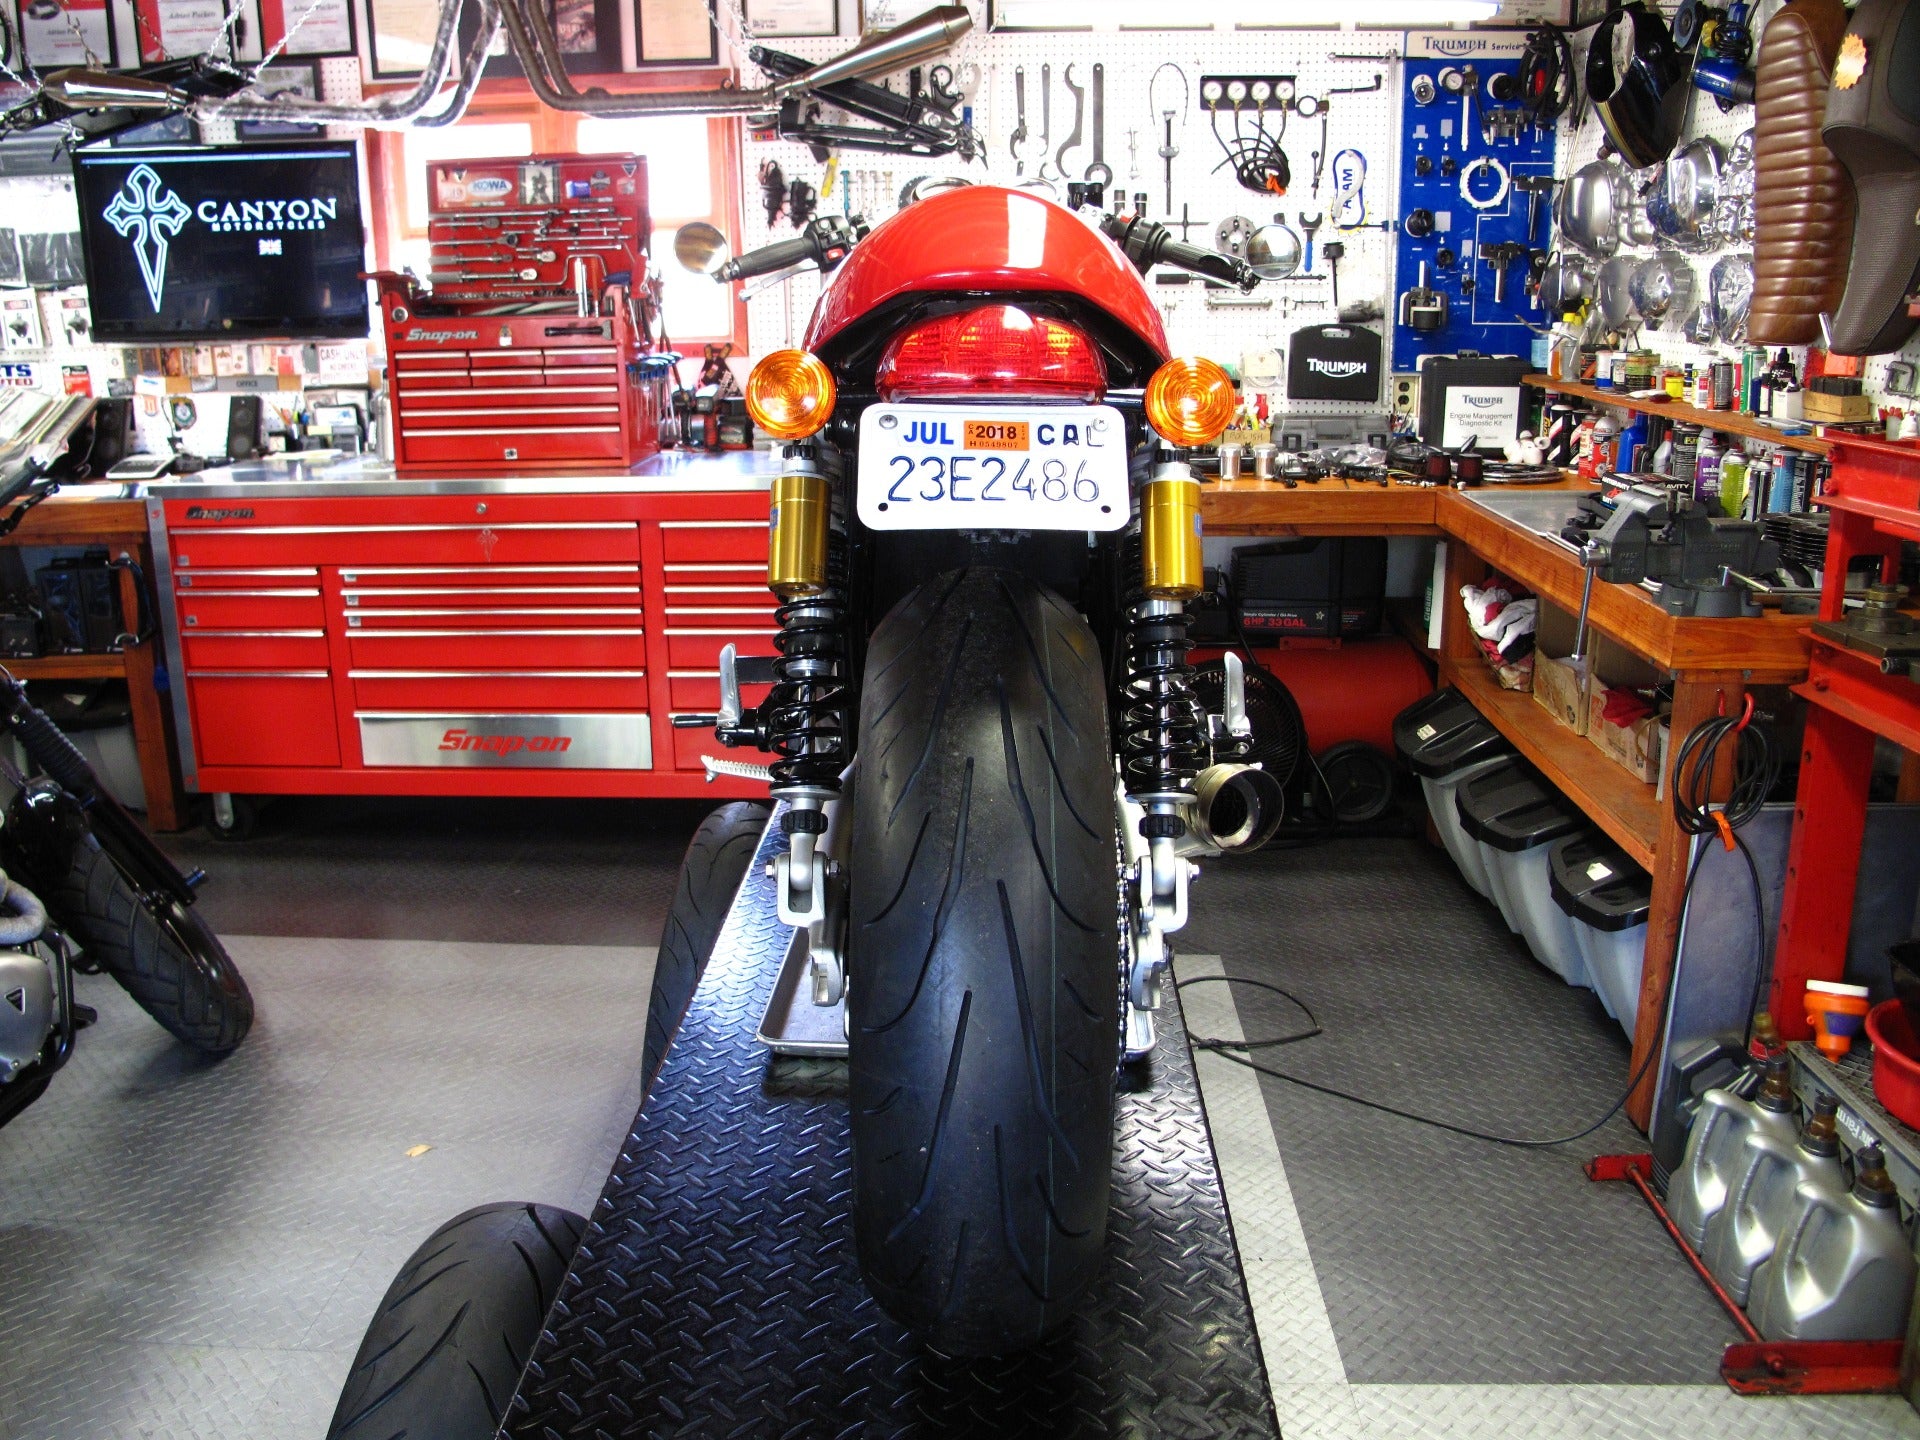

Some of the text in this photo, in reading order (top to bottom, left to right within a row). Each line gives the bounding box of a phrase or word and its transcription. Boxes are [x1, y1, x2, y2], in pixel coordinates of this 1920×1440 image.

[473, 180, 507, 190] KOWA
[197, 198, 337, 222] CANYON
[211, 220, 326, 232] MOTORCYCLES
[406, 327, 479, 344] Snap-on
[0, 363, 32, 377] TS
[1306, 358, 1367, 378] TRIUMPH
[235, 380, 258, 388] OFFICE
[1462, 394, 1503, 408] TRIUMPH
[1449, 412, 1513, 420] Engine Management
[1459, 419, 1503, 428] Diagnostic Kit
[903, 421, 954, 445] JUL
[1037, 424, 1105, 447] CAL
[975, 425, 1017, 440] 2018
[887, 455, 1100, 502] 23E2486
[186, 505, 256, 522] Snap-on
[1423, 586, 1433, 622] Cleaner
[437, 728, 573, 757] Snap-on
